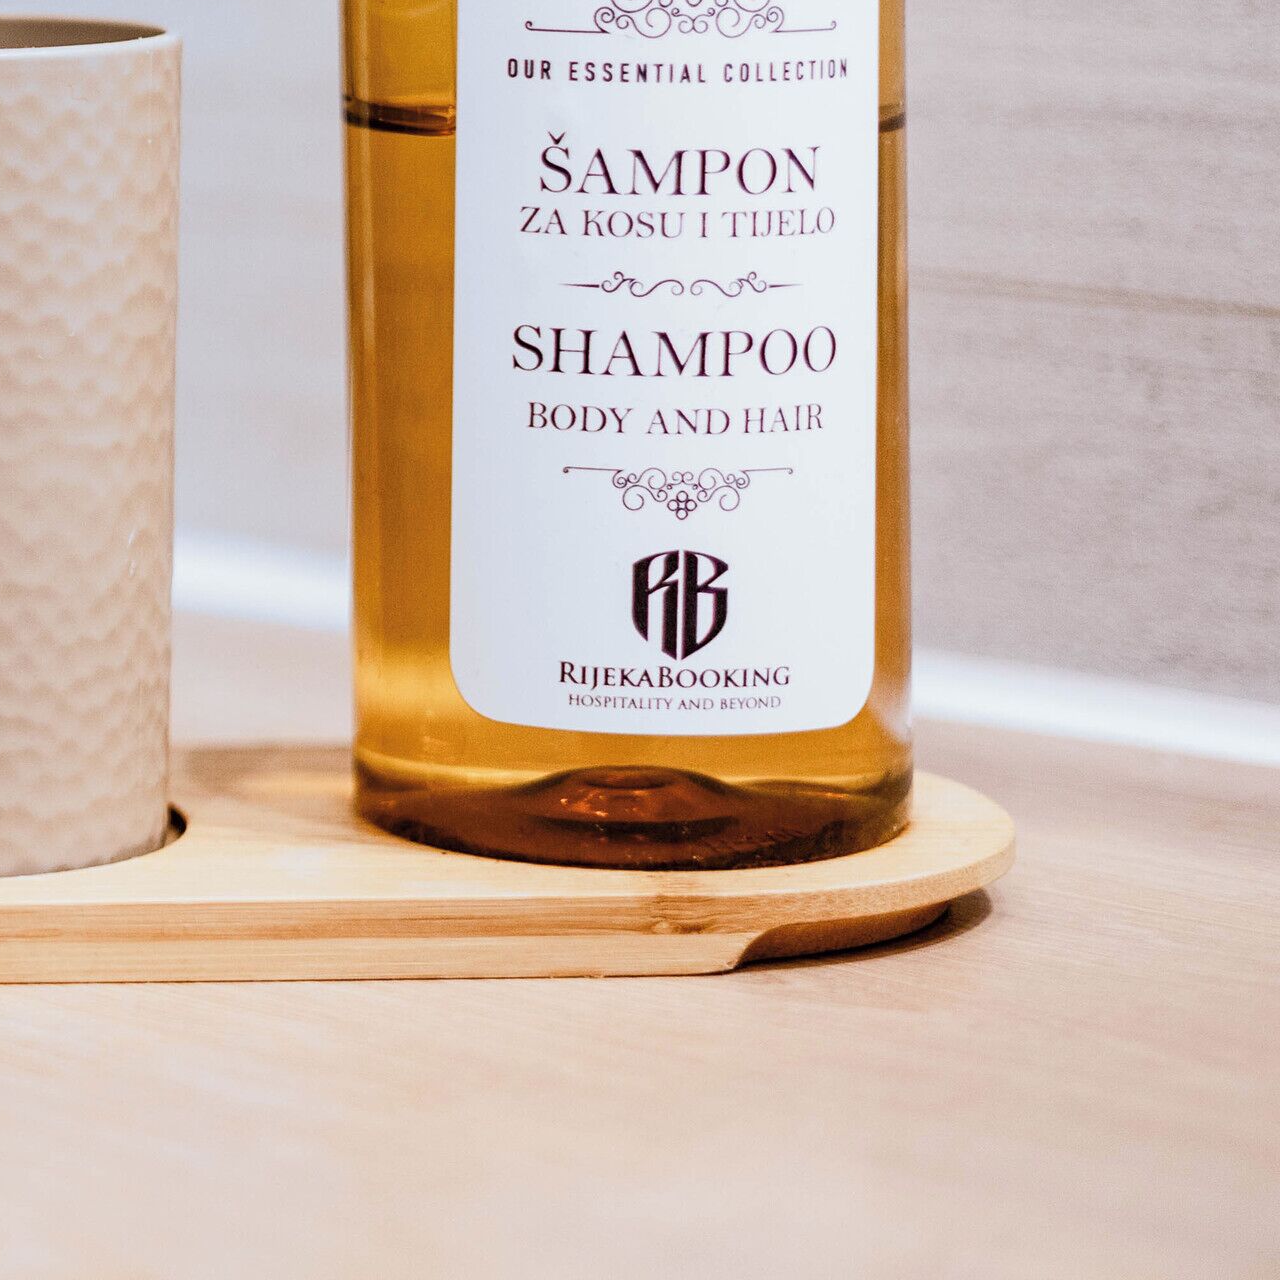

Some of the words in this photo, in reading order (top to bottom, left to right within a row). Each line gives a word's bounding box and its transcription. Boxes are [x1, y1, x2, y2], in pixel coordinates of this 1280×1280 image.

[507, 58, 551, 80] OUR
[569, 61, 706, 83] ESSENTIAL
[724, 59, 846, 83] COLLECTION
[540, 131, 819, 195] ŠAMPON
[520, 206, 567, 235] ZA
[582, 210, 685, 238] KOSU
[701, 212, 708, 238] I
[722, 208, 835, 237] TIJELO
[512, 325, 836, 377] SHAMPOO
[528, 402, 632, 433] BODY
[646, 409, 730, 435] AND
[744, 404, 822, 433] HAIR
[569, 694, 672, 709] HOSPITALITY
[678, 699, 714, 710] AND
[721, 696, 780, 709] BEYOND
